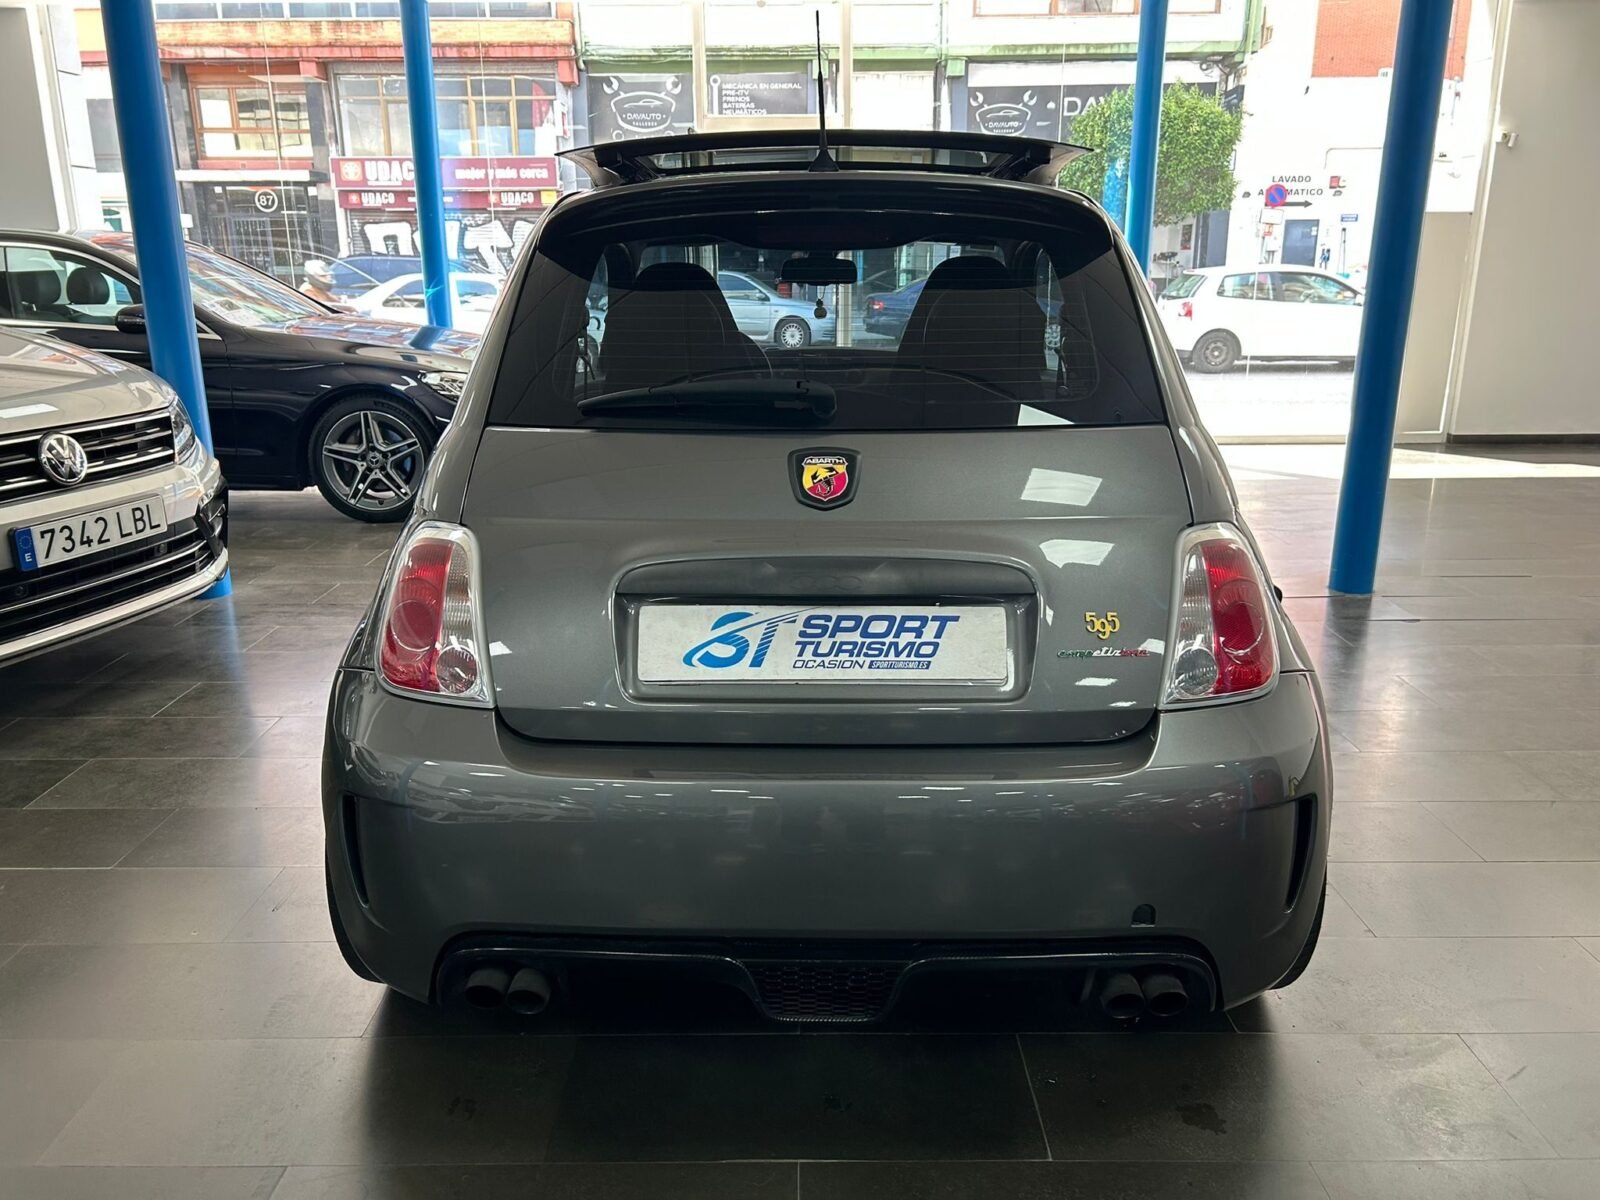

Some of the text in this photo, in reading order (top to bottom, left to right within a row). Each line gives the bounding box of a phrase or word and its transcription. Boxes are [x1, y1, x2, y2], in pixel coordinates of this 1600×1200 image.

[364, 160, 415, 181] UDAC
[519, 168, 549, 179] cerca
[1271, 175, 1312, 183] LAVADO
[361, 191, 395, 205] UDACO
[500, 191, 535, 205] UDACO
[1257, 188, 1324, 197] AMATICO
[259, 195, 273, 205] 87
[40, 503, 161, 560] 7342 LBL
[25, 552, 33, 562] E
[797, 614, 960, 639] SPORT
[1085, 611, 1120, 640] 595
[794, 641, 940, 658] TURISMO
[792, 659, 866, 670] OCASION
